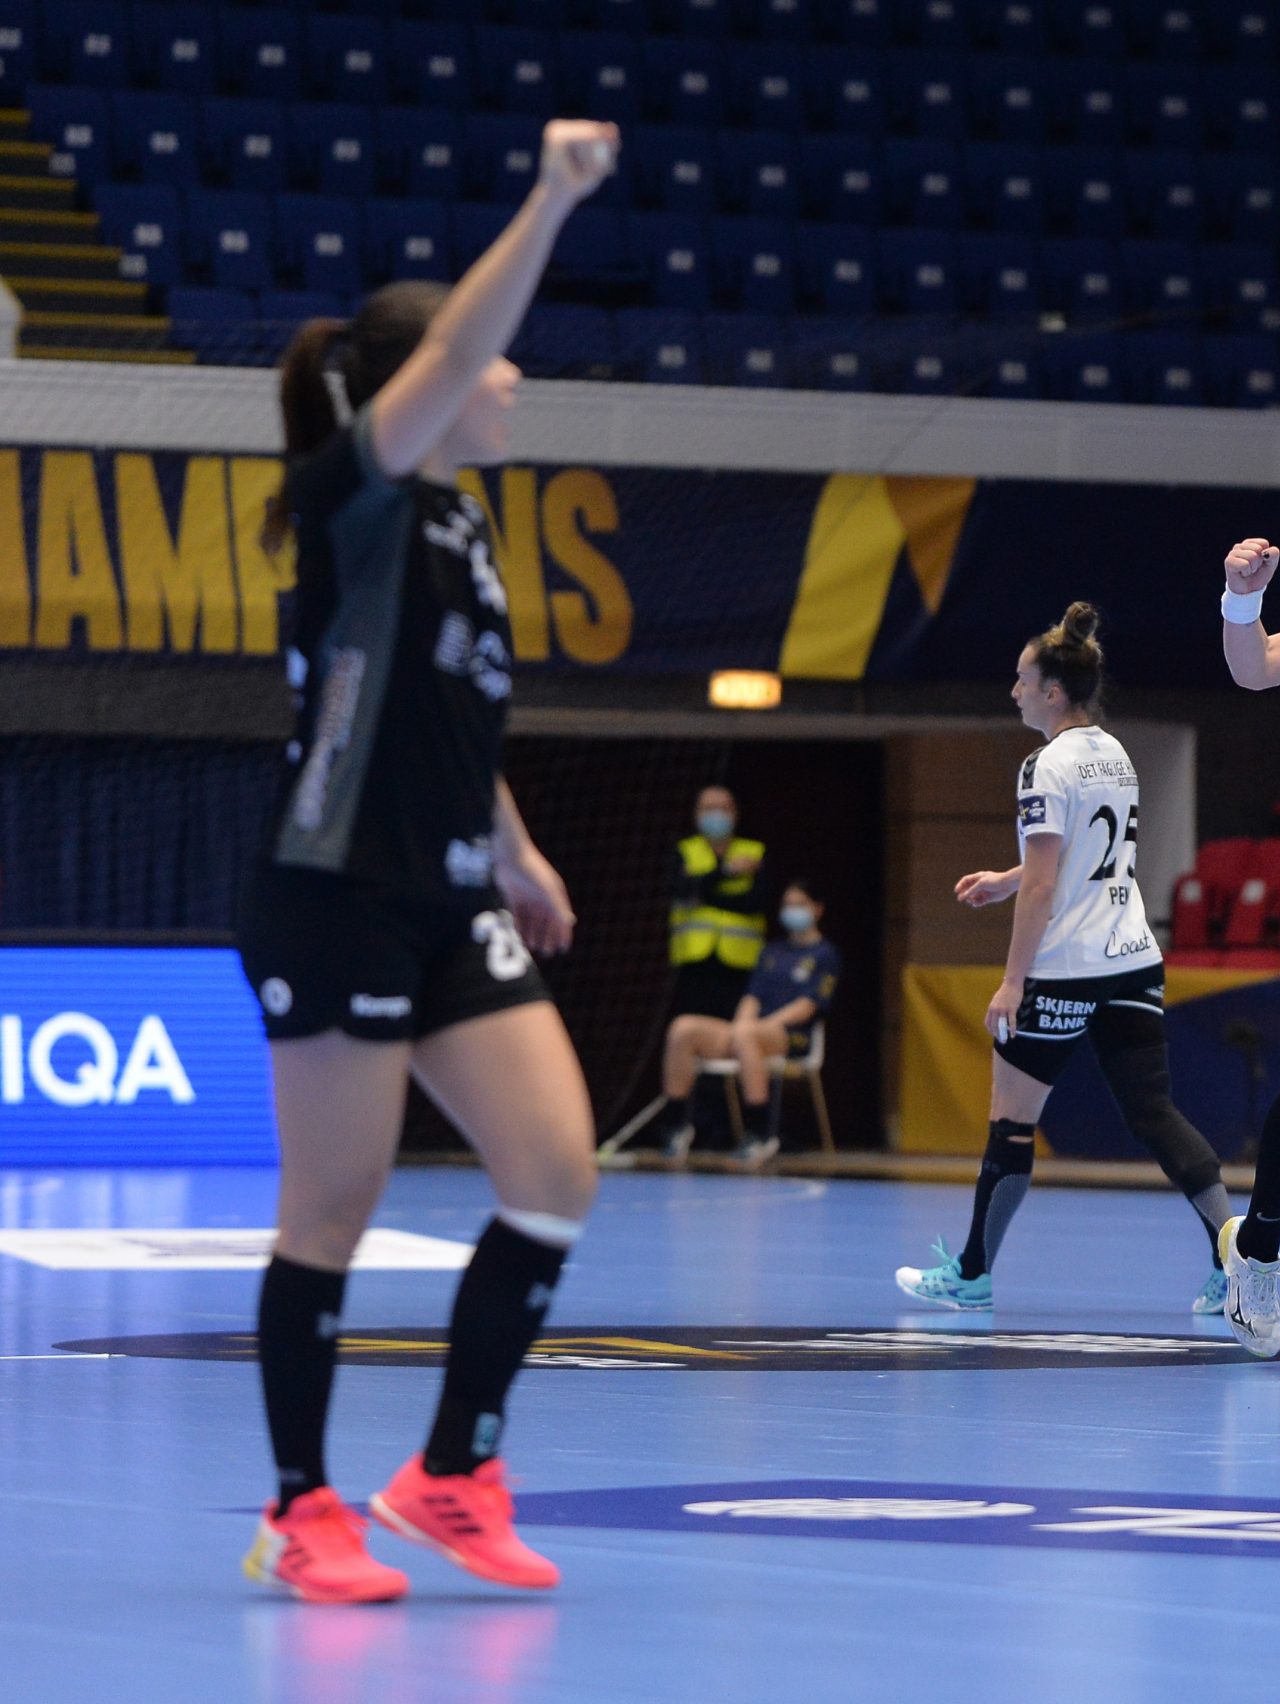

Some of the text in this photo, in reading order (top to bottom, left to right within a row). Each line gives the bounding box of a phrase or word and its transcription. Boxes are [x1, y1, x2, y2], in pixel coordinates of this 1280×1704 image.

[1078, 763, 1098, 780] DET
[1105, 930, 1151, 958] Coast
[1035, 995, 1097, 1015] SKJERN
[1039, 1014, 1087, 1030] BANK
